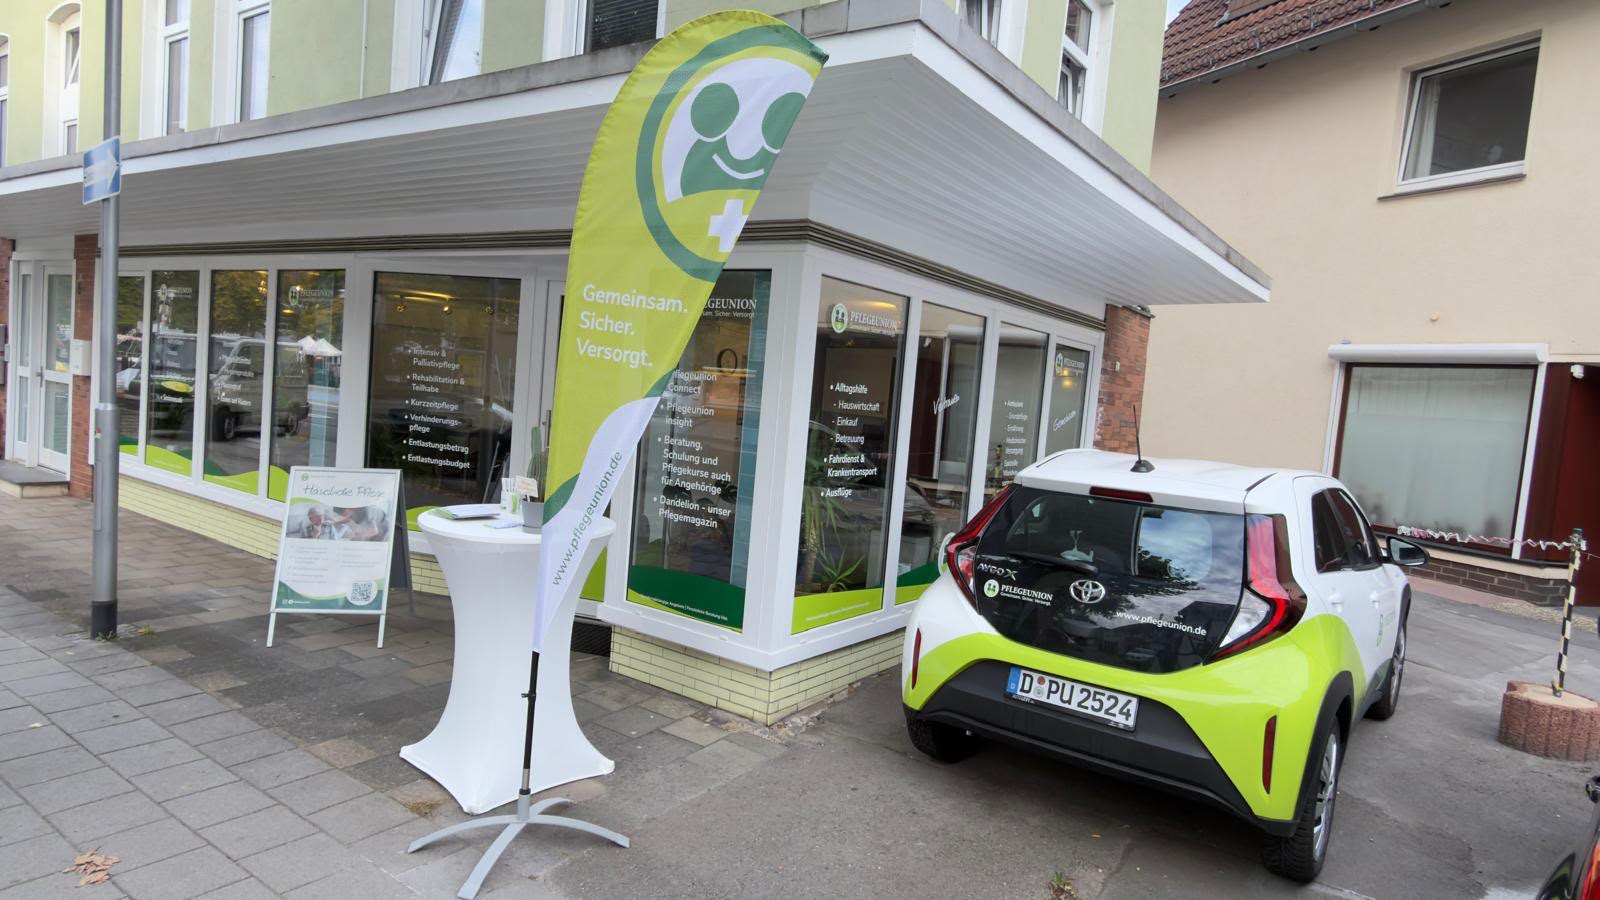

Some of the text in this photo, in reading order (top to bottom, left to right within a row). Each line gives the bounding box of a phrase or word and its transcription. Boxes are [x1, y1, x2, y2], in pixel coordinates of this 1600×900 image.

[583, 284, 688, 313] Gemeinsam.
[704, 297, 757, 310] GEUNION
[579, 311, 635, 336] Sicher.
[576, 337, 653, 369] Versorgt.
[413, 357, 460, 371] Palliativpflege
[412, 373, 465, 385] Rehabilitation &
[673, 369, 717, 382] flegeunion
[411, 383, 440, 393] Teilhabe
[834, 382, 868, 395] Alltagshilfe
[410, 398, 459, 411] Kurzzeitpflege
[666, 402, 715, 417] Pflegeunion
[838, 400, 880, 412] Hauswirtschaft
[409, 413, 462, 427] Verhinderungs-
[665, 416, 694, 428] insight
[837, 416, 859, 427] Einkauf
[409, 423, 430, 434] pflege
[663, 435, 703, 451] Beratung,
[835, 433, 865, 445] Betreuung
[408, 438, 470, 455] Entlastungsbetrag
[407, 454, 470, 469] Entlastungsbudget
[663, 448, 718, 466] Schulung und
[828, 454, 865, 465] Fahrdienst &
[662, 463, 731, 482] Pflegekurse auch
[827, 465, 878, 478] Krankentransport
[661, 476, 722, 496] für Angehörige
[825, 487, 852, 498] Ausflüge
[659, 495, 700, 511] Dandelion
[708, 506, 731, 517] unser
[552, 450, 623, 586] www.pflegeunion.de
[658, 509, 718, 529] Pflegemagazin
[977, 562, 1005, 576] AYGO
[1001, 584, 1053, 601] PFLEGEUNION
[1116, 611, 1207, 636] www.pflegeunion.de
[1019, 672, 1034, 694] D
[1046, 679, 1075, 706] PU
[1076, 687, 1132, 721] 2524
